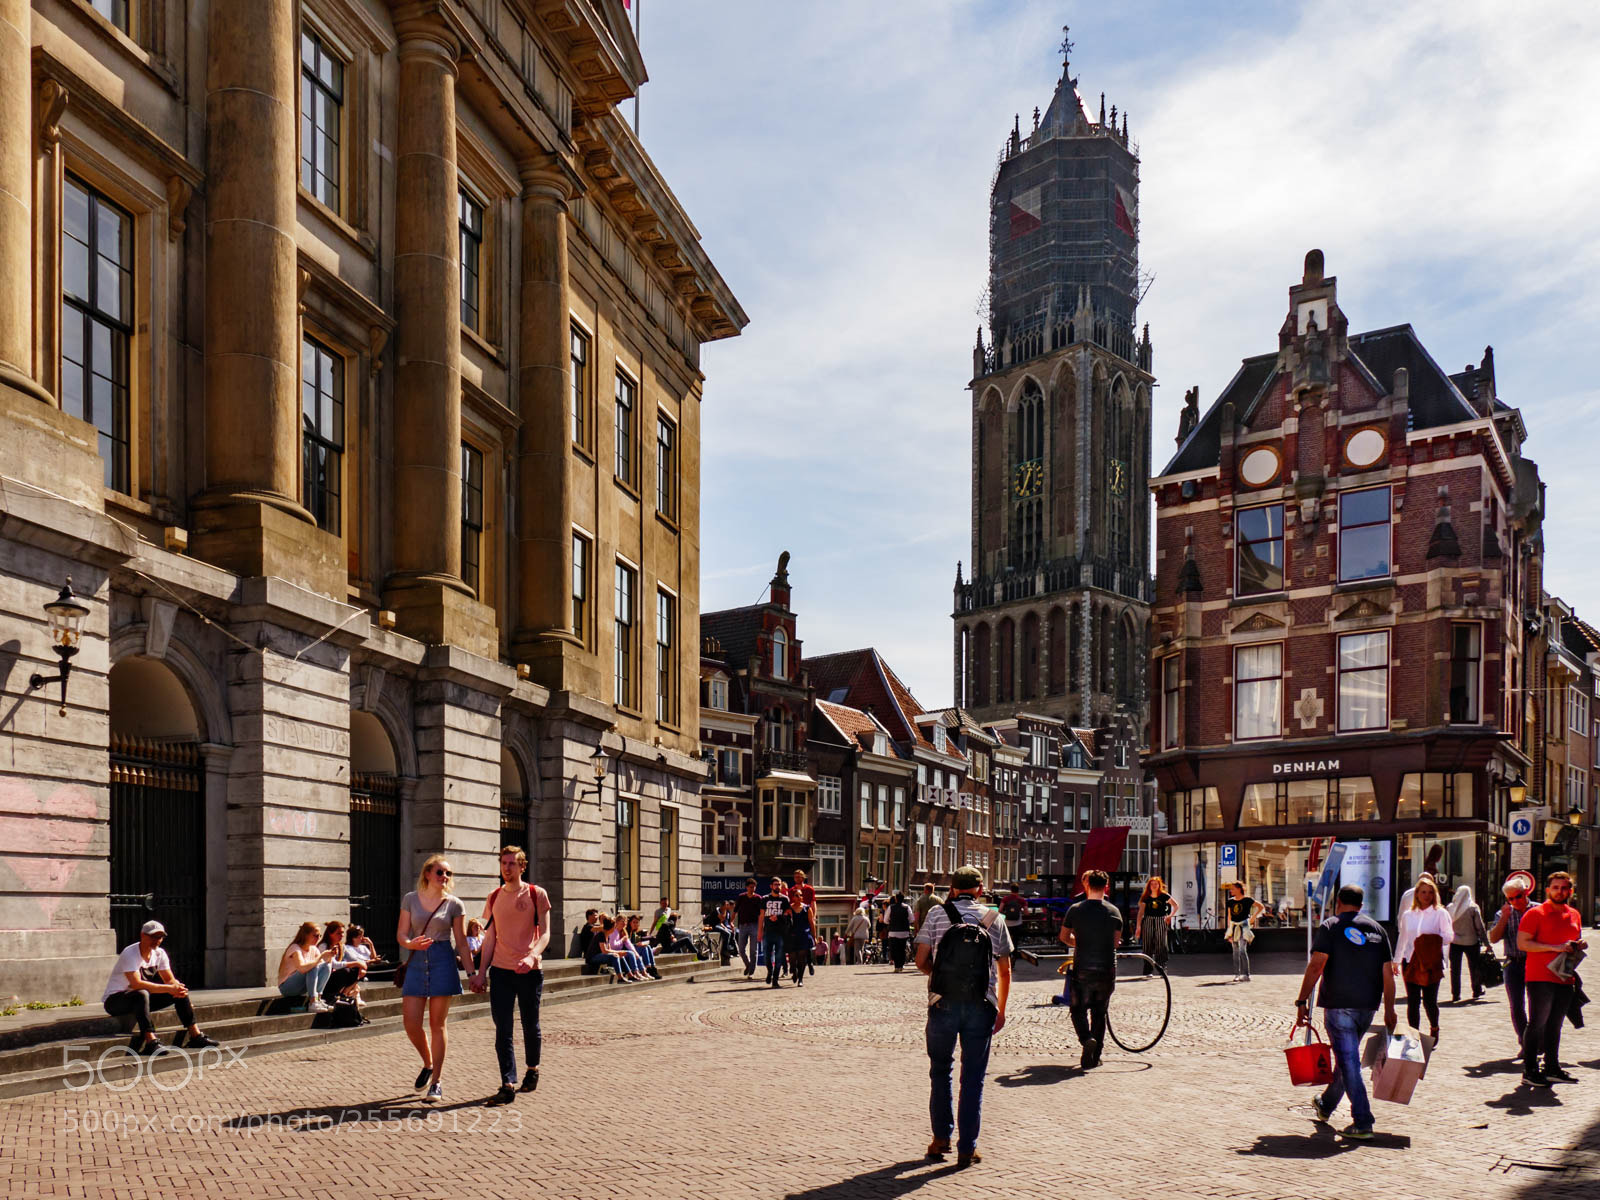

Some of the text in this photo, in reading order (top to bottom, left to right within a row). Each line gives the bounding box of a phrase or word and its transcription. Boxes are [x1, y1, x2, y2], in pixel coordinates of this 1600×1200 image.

[1273, 760, 1340, 774] DENHAM
[1224, 847, 1234, 859] P
[766, 900, 783, 909] GET
